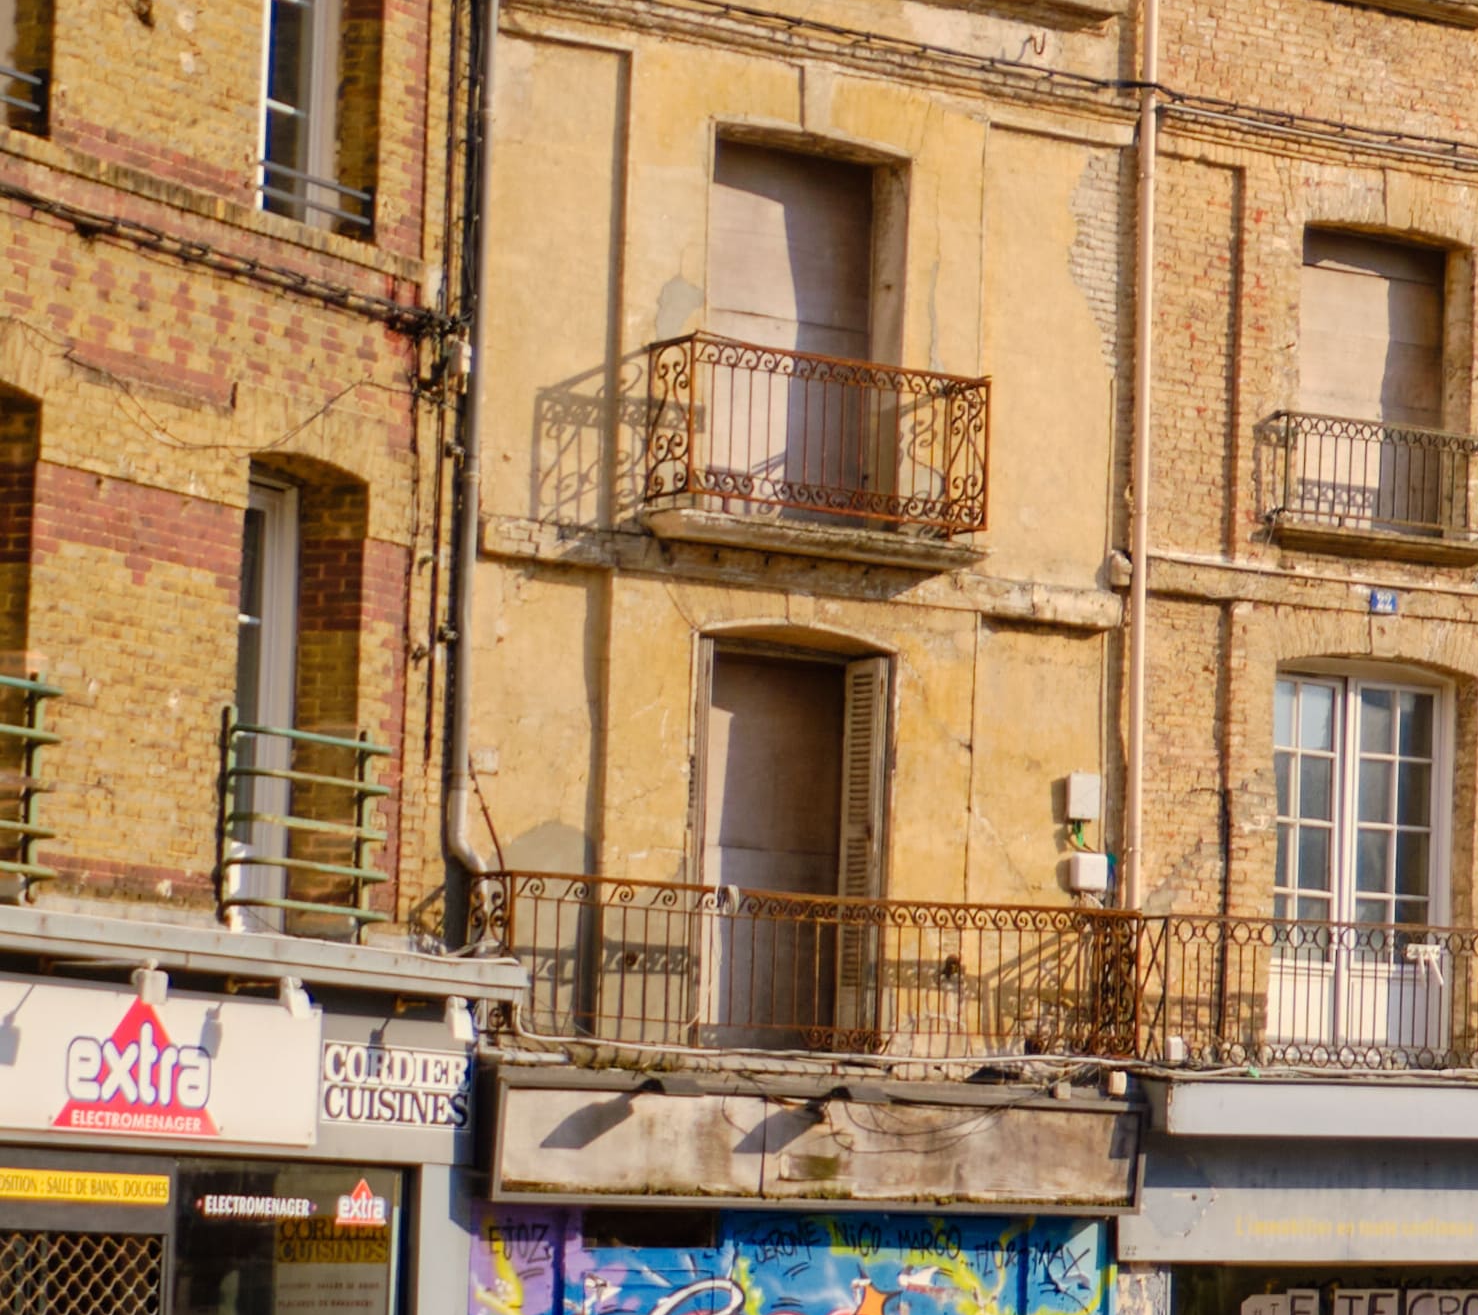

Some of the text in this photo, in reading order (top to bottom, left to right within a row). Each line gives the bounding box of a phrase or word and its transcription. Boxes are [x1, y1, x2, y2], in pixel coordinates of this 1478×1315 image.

[65, 1021, 212, 1110] extra
[324, 1044, 469, 1090] CORDIER
[71, 1110, 201, 1132] ELECTROMENAGER
[323, 1085, 469, 1128] CUISINES
[47, 1176, 74, 1194] SALLE
[76, 1177, 88, 1194] DE
[124, 1179, 168, 1198] DOUCHES
[204, 1190, 386, 1219] ELECTROMENAGER extra
